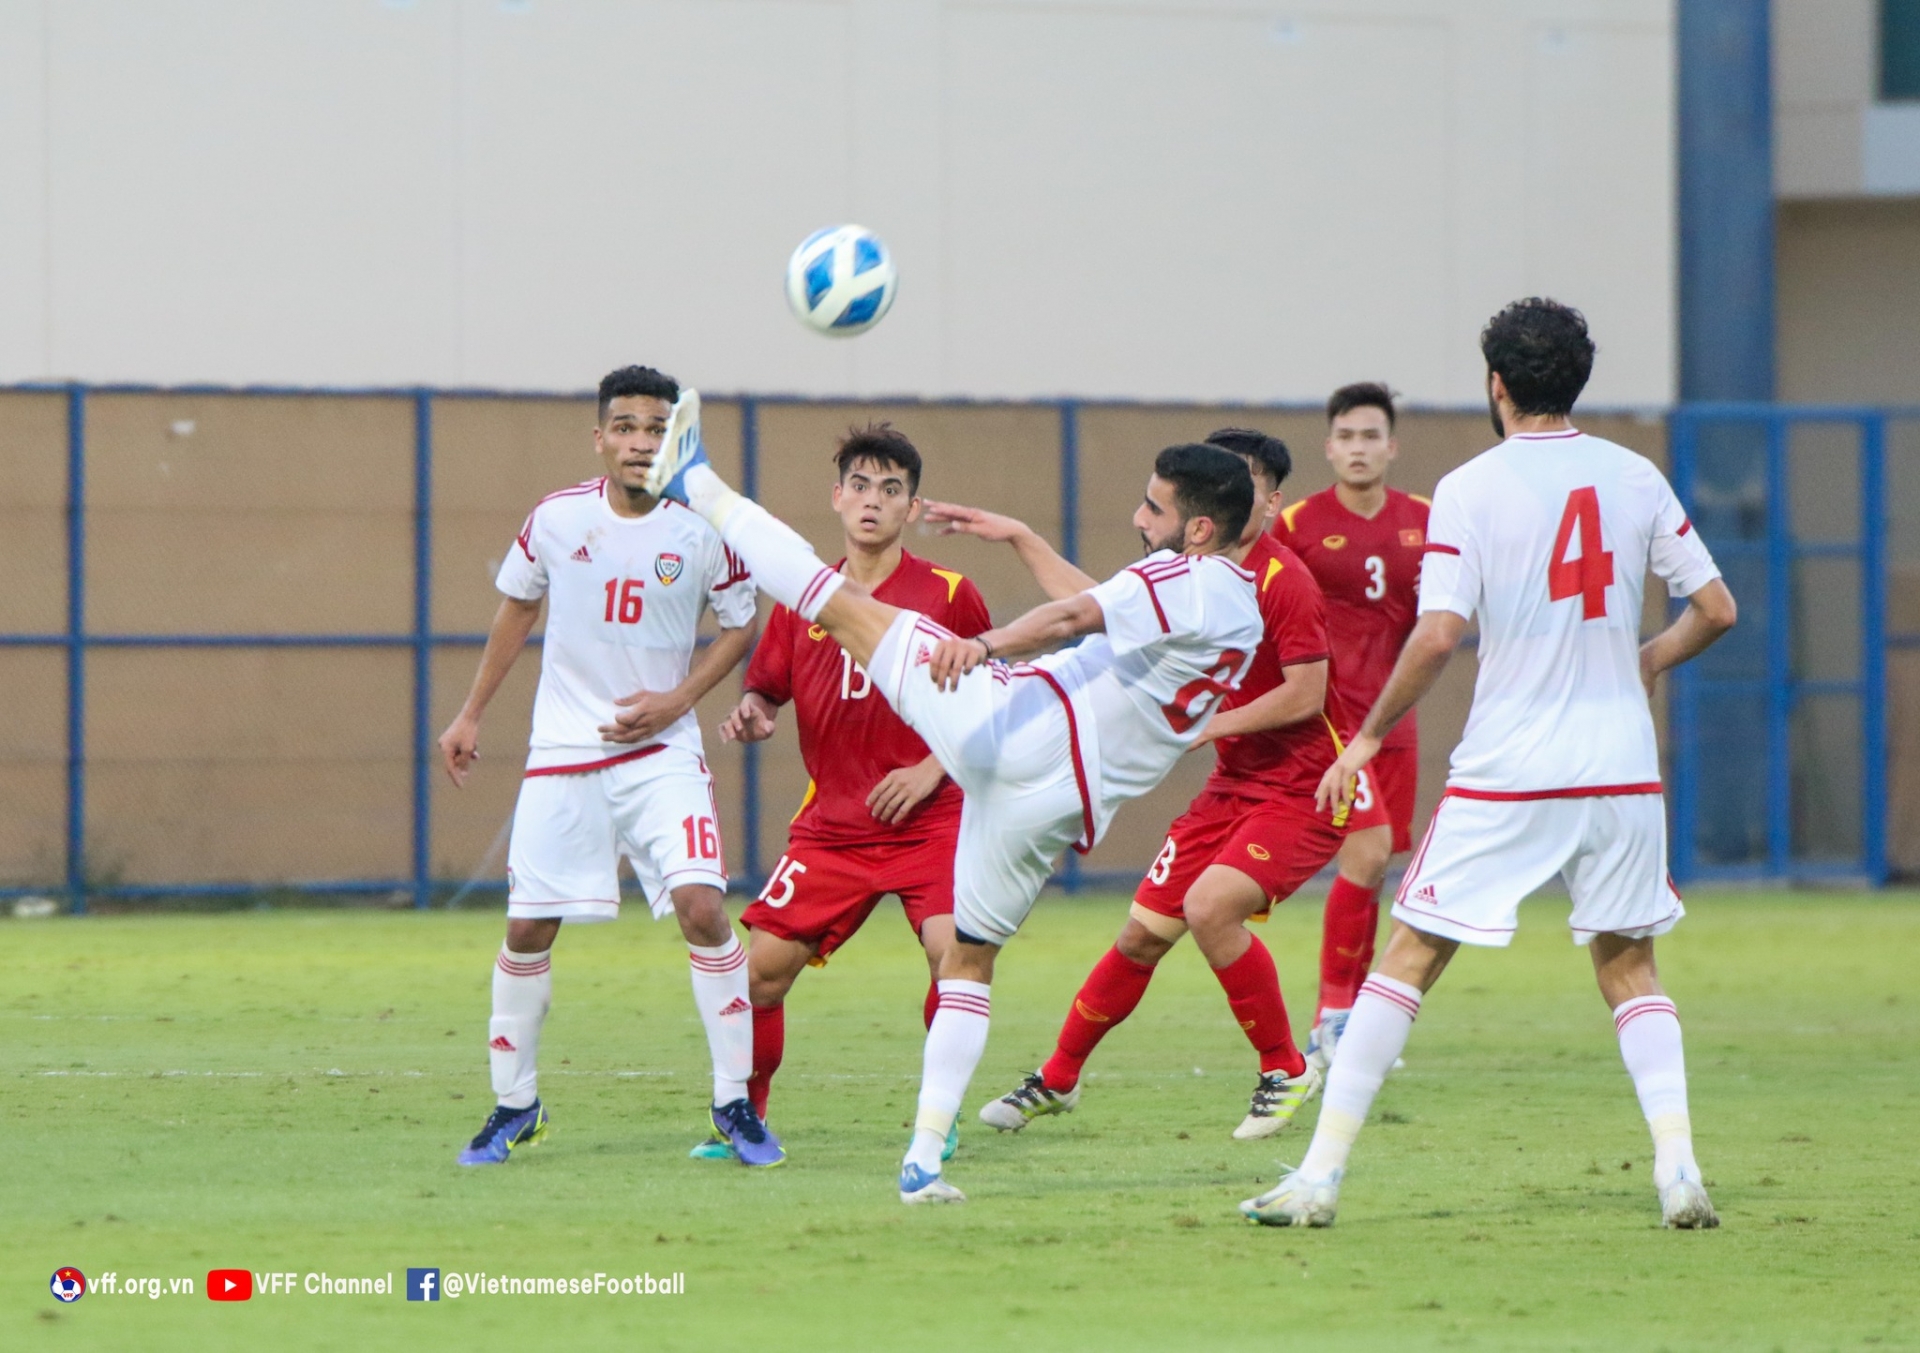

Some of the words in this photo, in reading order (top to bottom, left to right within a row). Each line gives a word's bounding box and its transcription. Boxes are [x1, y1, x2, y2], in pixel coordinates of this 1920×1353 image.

[1548, 486, 1614, 621] 4
[605, 577, 644, 624] 16
[1365, 556, 1385, 600] 3
[682, 815, 717, 859] 16
[757, 854, 808, 908] 15
